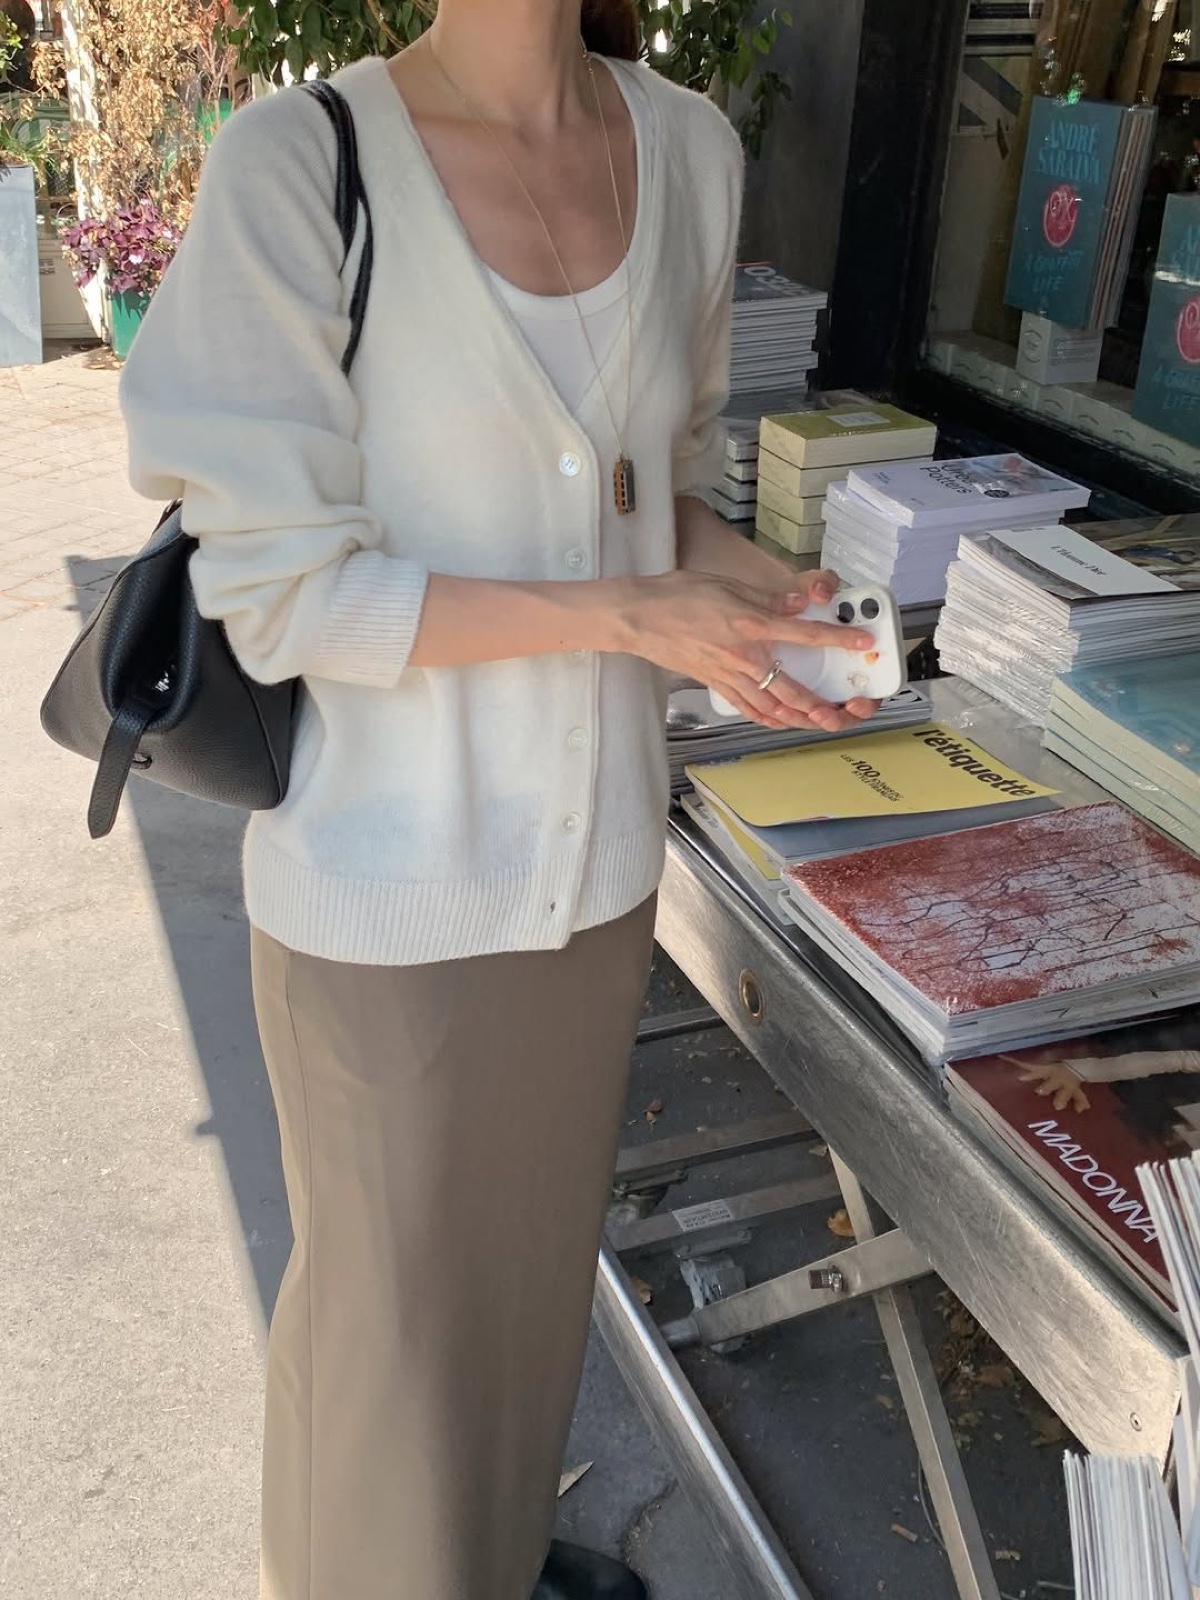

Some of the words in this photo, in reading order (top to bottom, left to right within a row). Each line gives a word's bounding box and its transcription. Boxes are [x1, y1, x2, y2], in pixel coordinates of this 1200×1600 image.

[919, 466, 972, 494] Potters
[851, 760, 881, 779] 100
[912, 729, 1036, 797] l'étiquette
[1027, 1119, 1159, 1243] MADONNA
